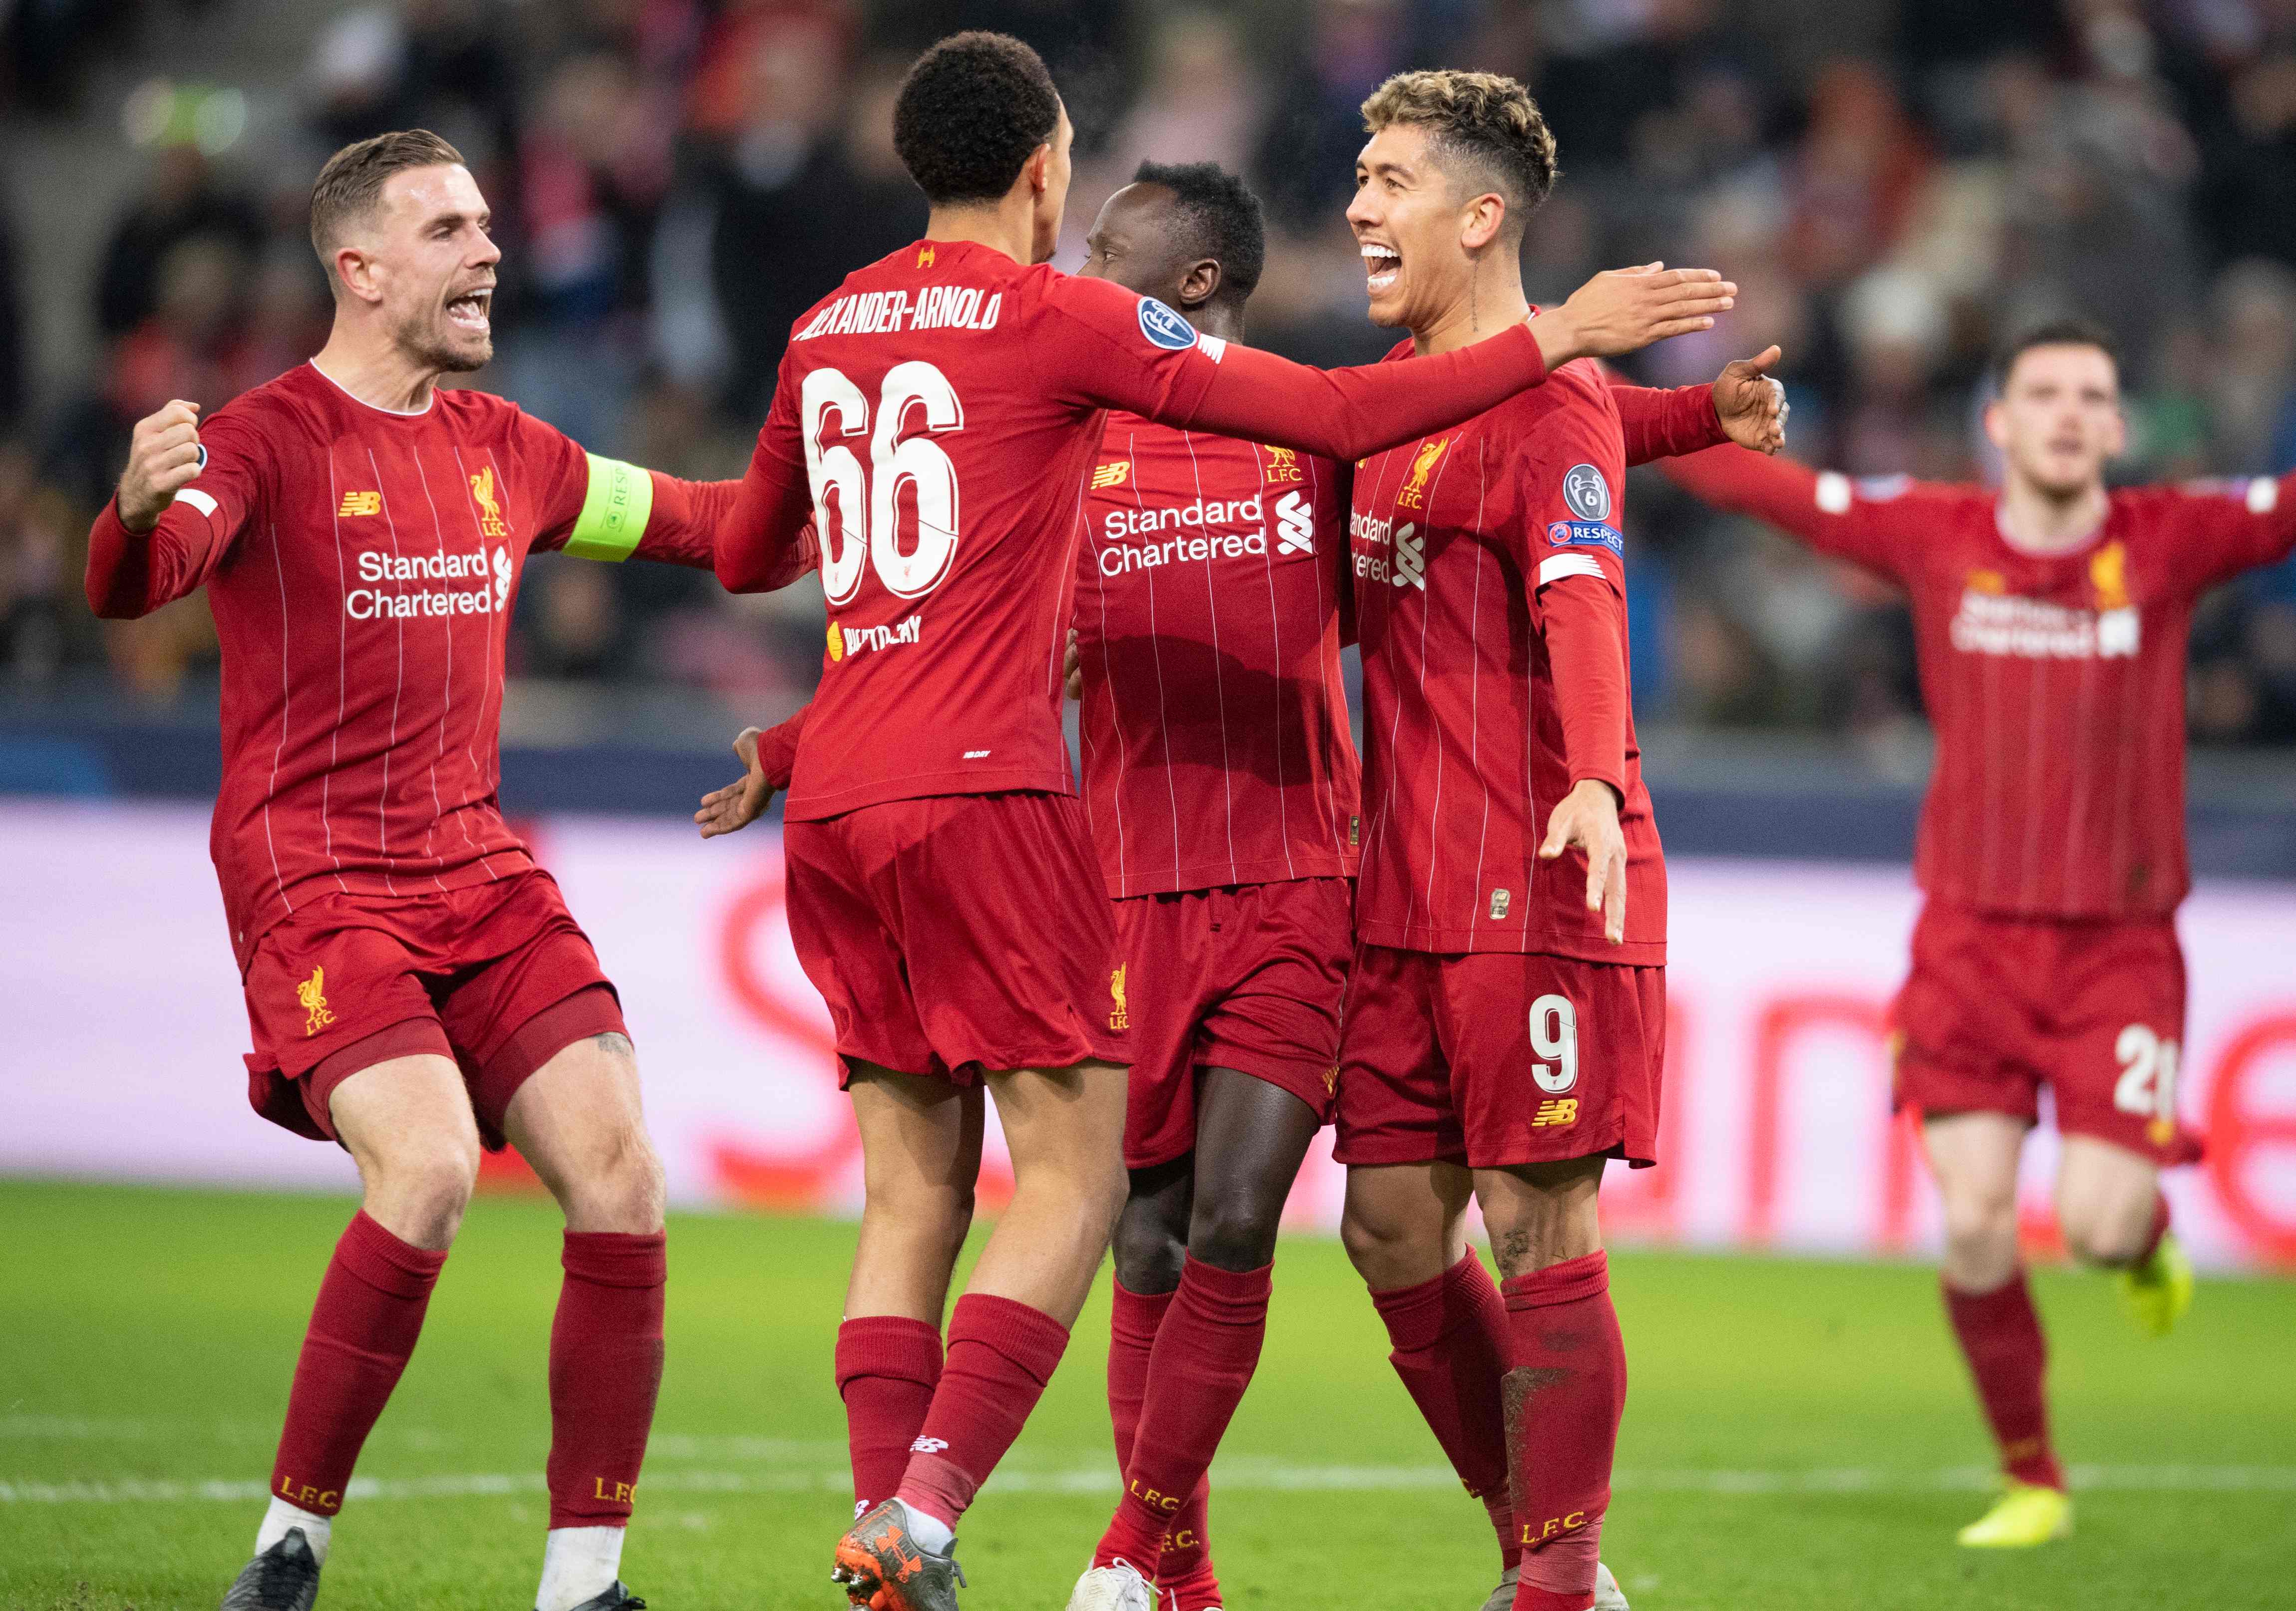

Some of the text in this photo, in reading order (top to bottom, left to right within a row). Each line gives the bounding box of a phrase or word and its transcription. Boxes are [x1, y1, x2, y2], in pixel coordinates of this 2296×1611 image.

[792, 286, 1002, 341] ALEXANDER-ARNOLD
[614, 466, 629, 506] RESP
[802, 360, 964, 606] 66
[1585, 491, 1597, 506] 6
[1105, 495, 1262, 539] Standard
[1350, 503, 1392, 545] andard
[1100, 527, 1266, 576] Chartered
[1573, 527, 1623, 551] RESPECT
[358, 547, 488, 581] Standard
[346, 583, 490, 619] Chartered
[1529, 994, 1578, 1094] 9
